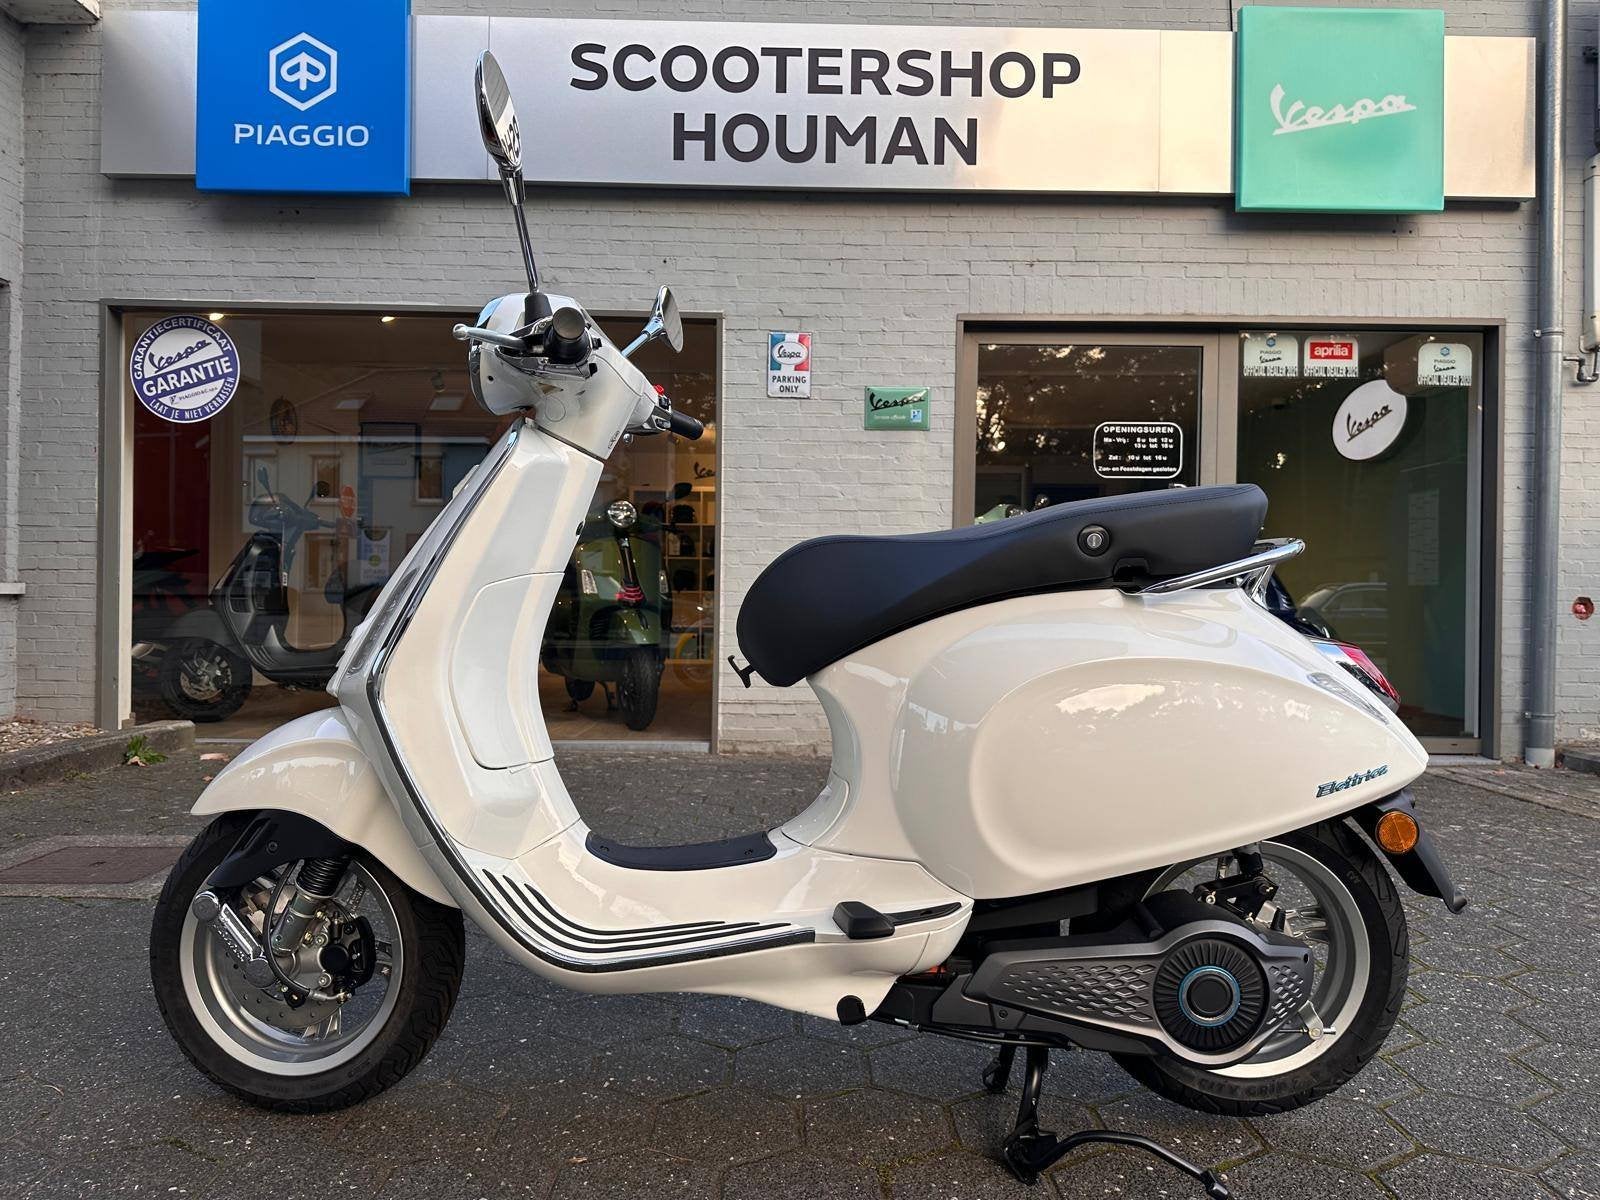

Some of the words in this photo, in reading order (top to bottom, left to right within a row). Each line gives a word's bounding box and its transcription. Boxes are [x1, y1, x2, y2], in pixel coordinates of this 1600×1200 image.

[569, 42, 1082, 98] SCOOTERSHOP
[1270, 83, 1417, 136] Vespa
[234, 123, 370, 147] PIAGGIO
[672, 112, 979, 166] HOUMAN
[134, 317, 232, 379] GARANTIECERTIFICAAT
[148, 339, 213, 374] Vespa
[777, 345, 802, 359] Vespa
[1314, 344, 1349, 358] aprilia
[142, 356, 233, 397] GARANTIE
[771, 375, 807, 384] PARKING
[1266, 366, 1285, 377] DEALER
[1326, 366, 1346, 378] DEALER
[1440, 375, 1459, 386] DEALER
[149, 398, 169, 415] LAAT
[170, 409, 180, 419] JE
[184, 409, 203, 419] NIET
[204, 376, 236, 414] VERRASSEN
[779, 385, 799, 393] ONLY
[869, 392, 925, 412] Vespa
[1103, 426, 1174, 434] OPENINGSUREN
[1346, 404, 1393, 442] Vespa
